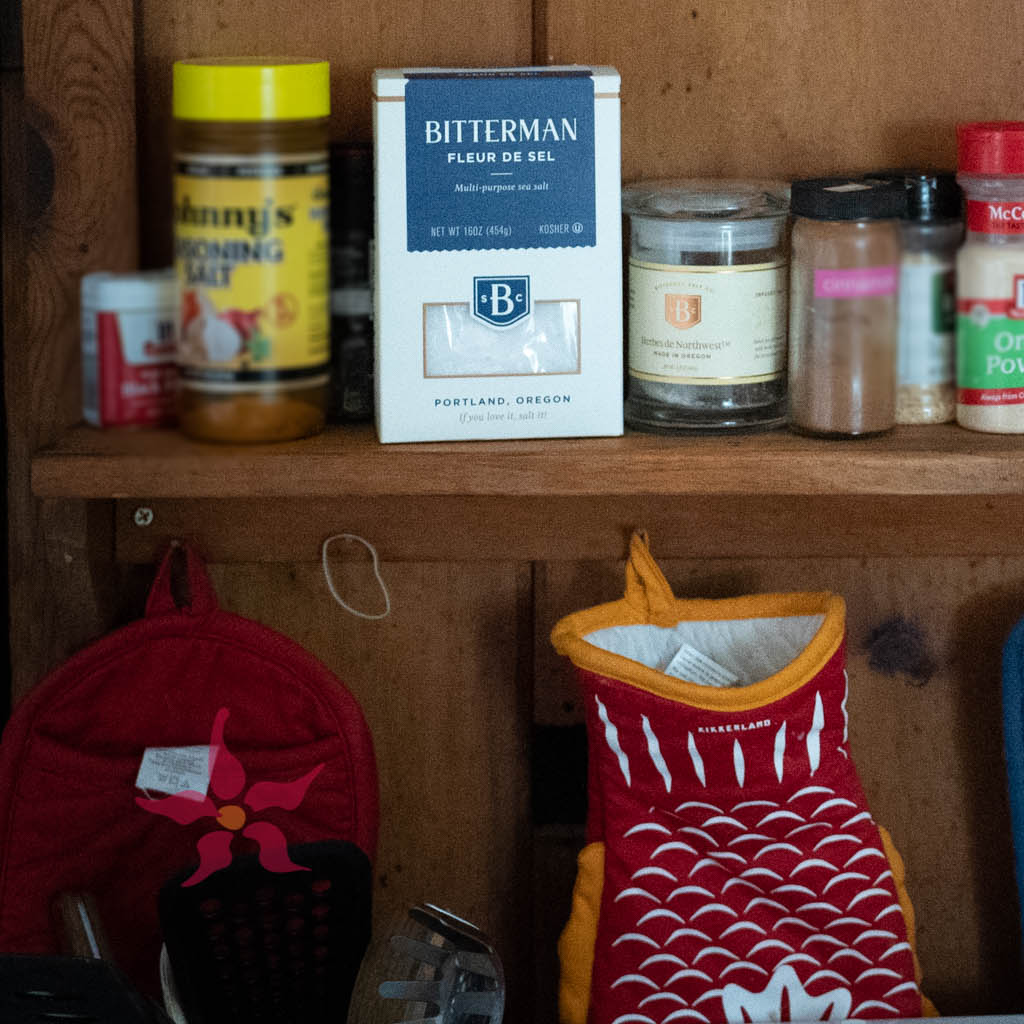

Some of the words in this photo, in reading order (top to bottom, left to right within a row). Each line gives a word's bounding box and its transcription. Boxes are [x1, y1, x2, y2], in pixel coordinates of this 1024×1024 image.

[425, 118, 578, 145] BITTERMAN
[447, 152, 497, 164] FLEUR
[502, 152, 522, 163] DE
[528, 151, 556, 162] SEL
[454, 183, 516, 194] Multi-purpose
[517, 183, 531, 191] sea
[533, 182, 549, 191] salt
[431, 227, 446, 237] NET
[448, 226, 460, 236] WT
[486, 225, 512, 237] (454g)
[539, 224, 570, 234] KOSHER
[490, 283, 515, 316] B
[434, 397, 510, 408] PORTLAND,
[516, 394, 572, 405] OREGON
[467, 413, 484, 423] you
[487, 410, 504, 421] love
[519, 410, 535, 420] salt
